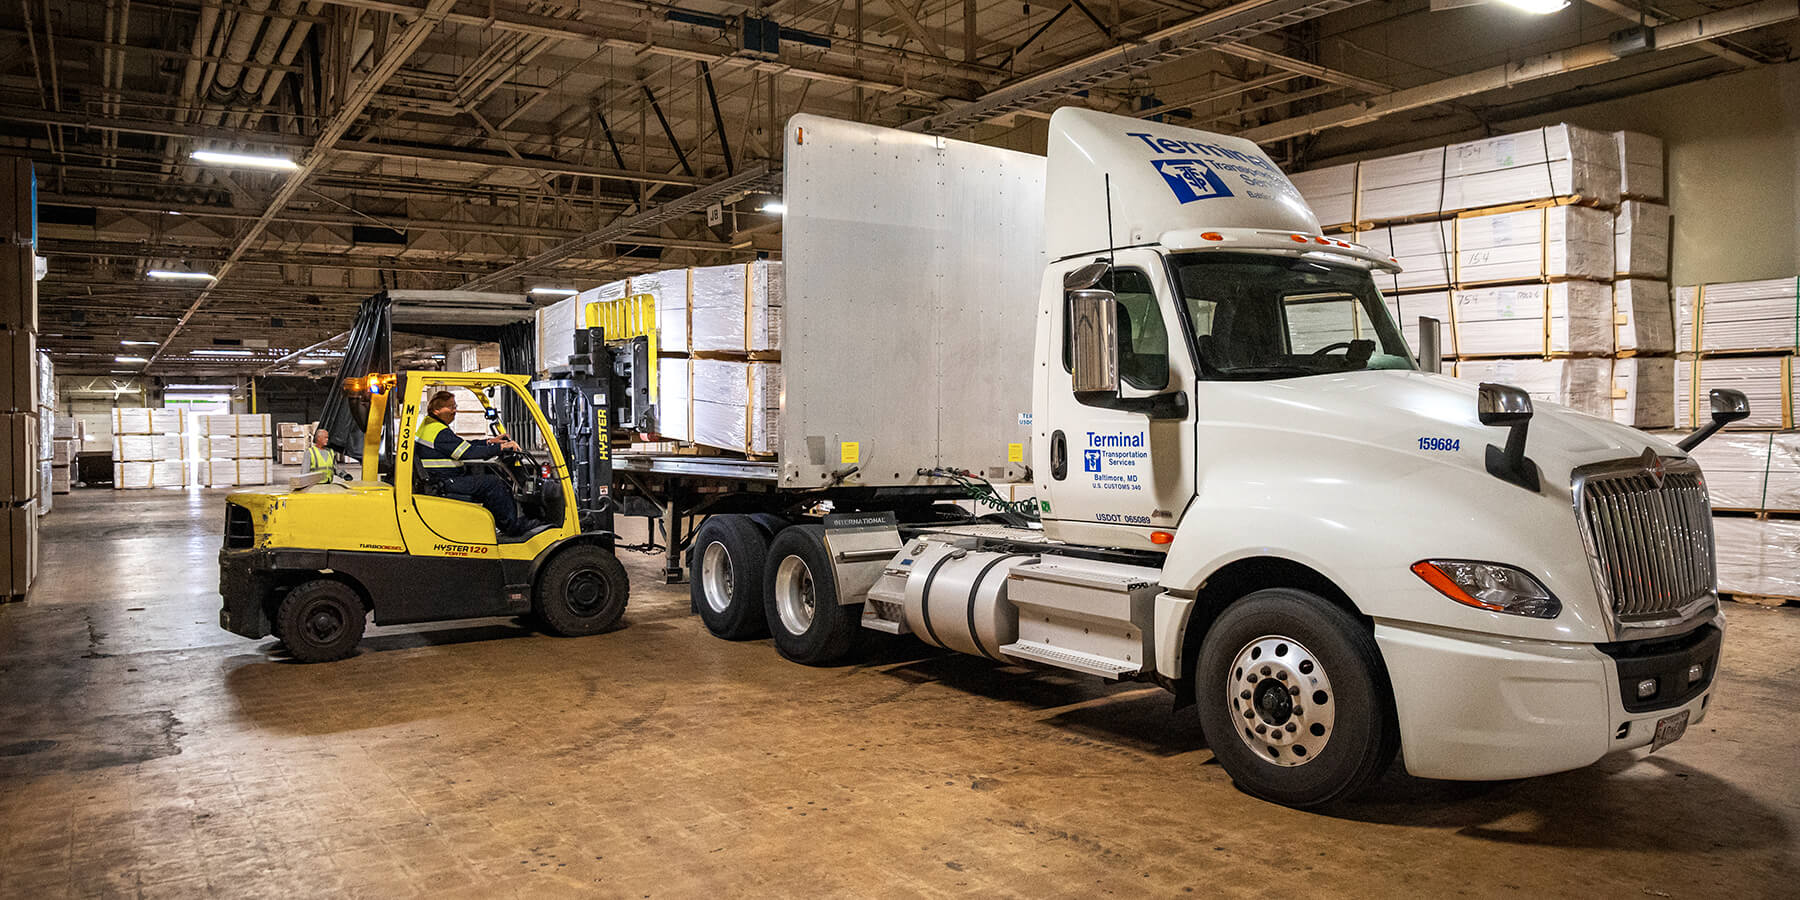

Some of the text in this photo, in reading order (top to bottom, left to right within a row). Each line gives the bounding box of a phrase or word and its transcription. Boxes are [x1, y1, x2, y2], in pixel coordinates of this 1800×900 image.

[401, 404, 415, 462] M1340
[597, 409, 609, 460] HYSTER
[1086, 431, 1144, 447] Terminal
[1418, 437, 1460, 451] 159684
[1102, 450, 1148, 458] Transportation
[1108, 458, 1136, 466] Services
[1094, 474, 1125, 482] Baltimore,
[1096, 513, 1121, 522] USDOT
